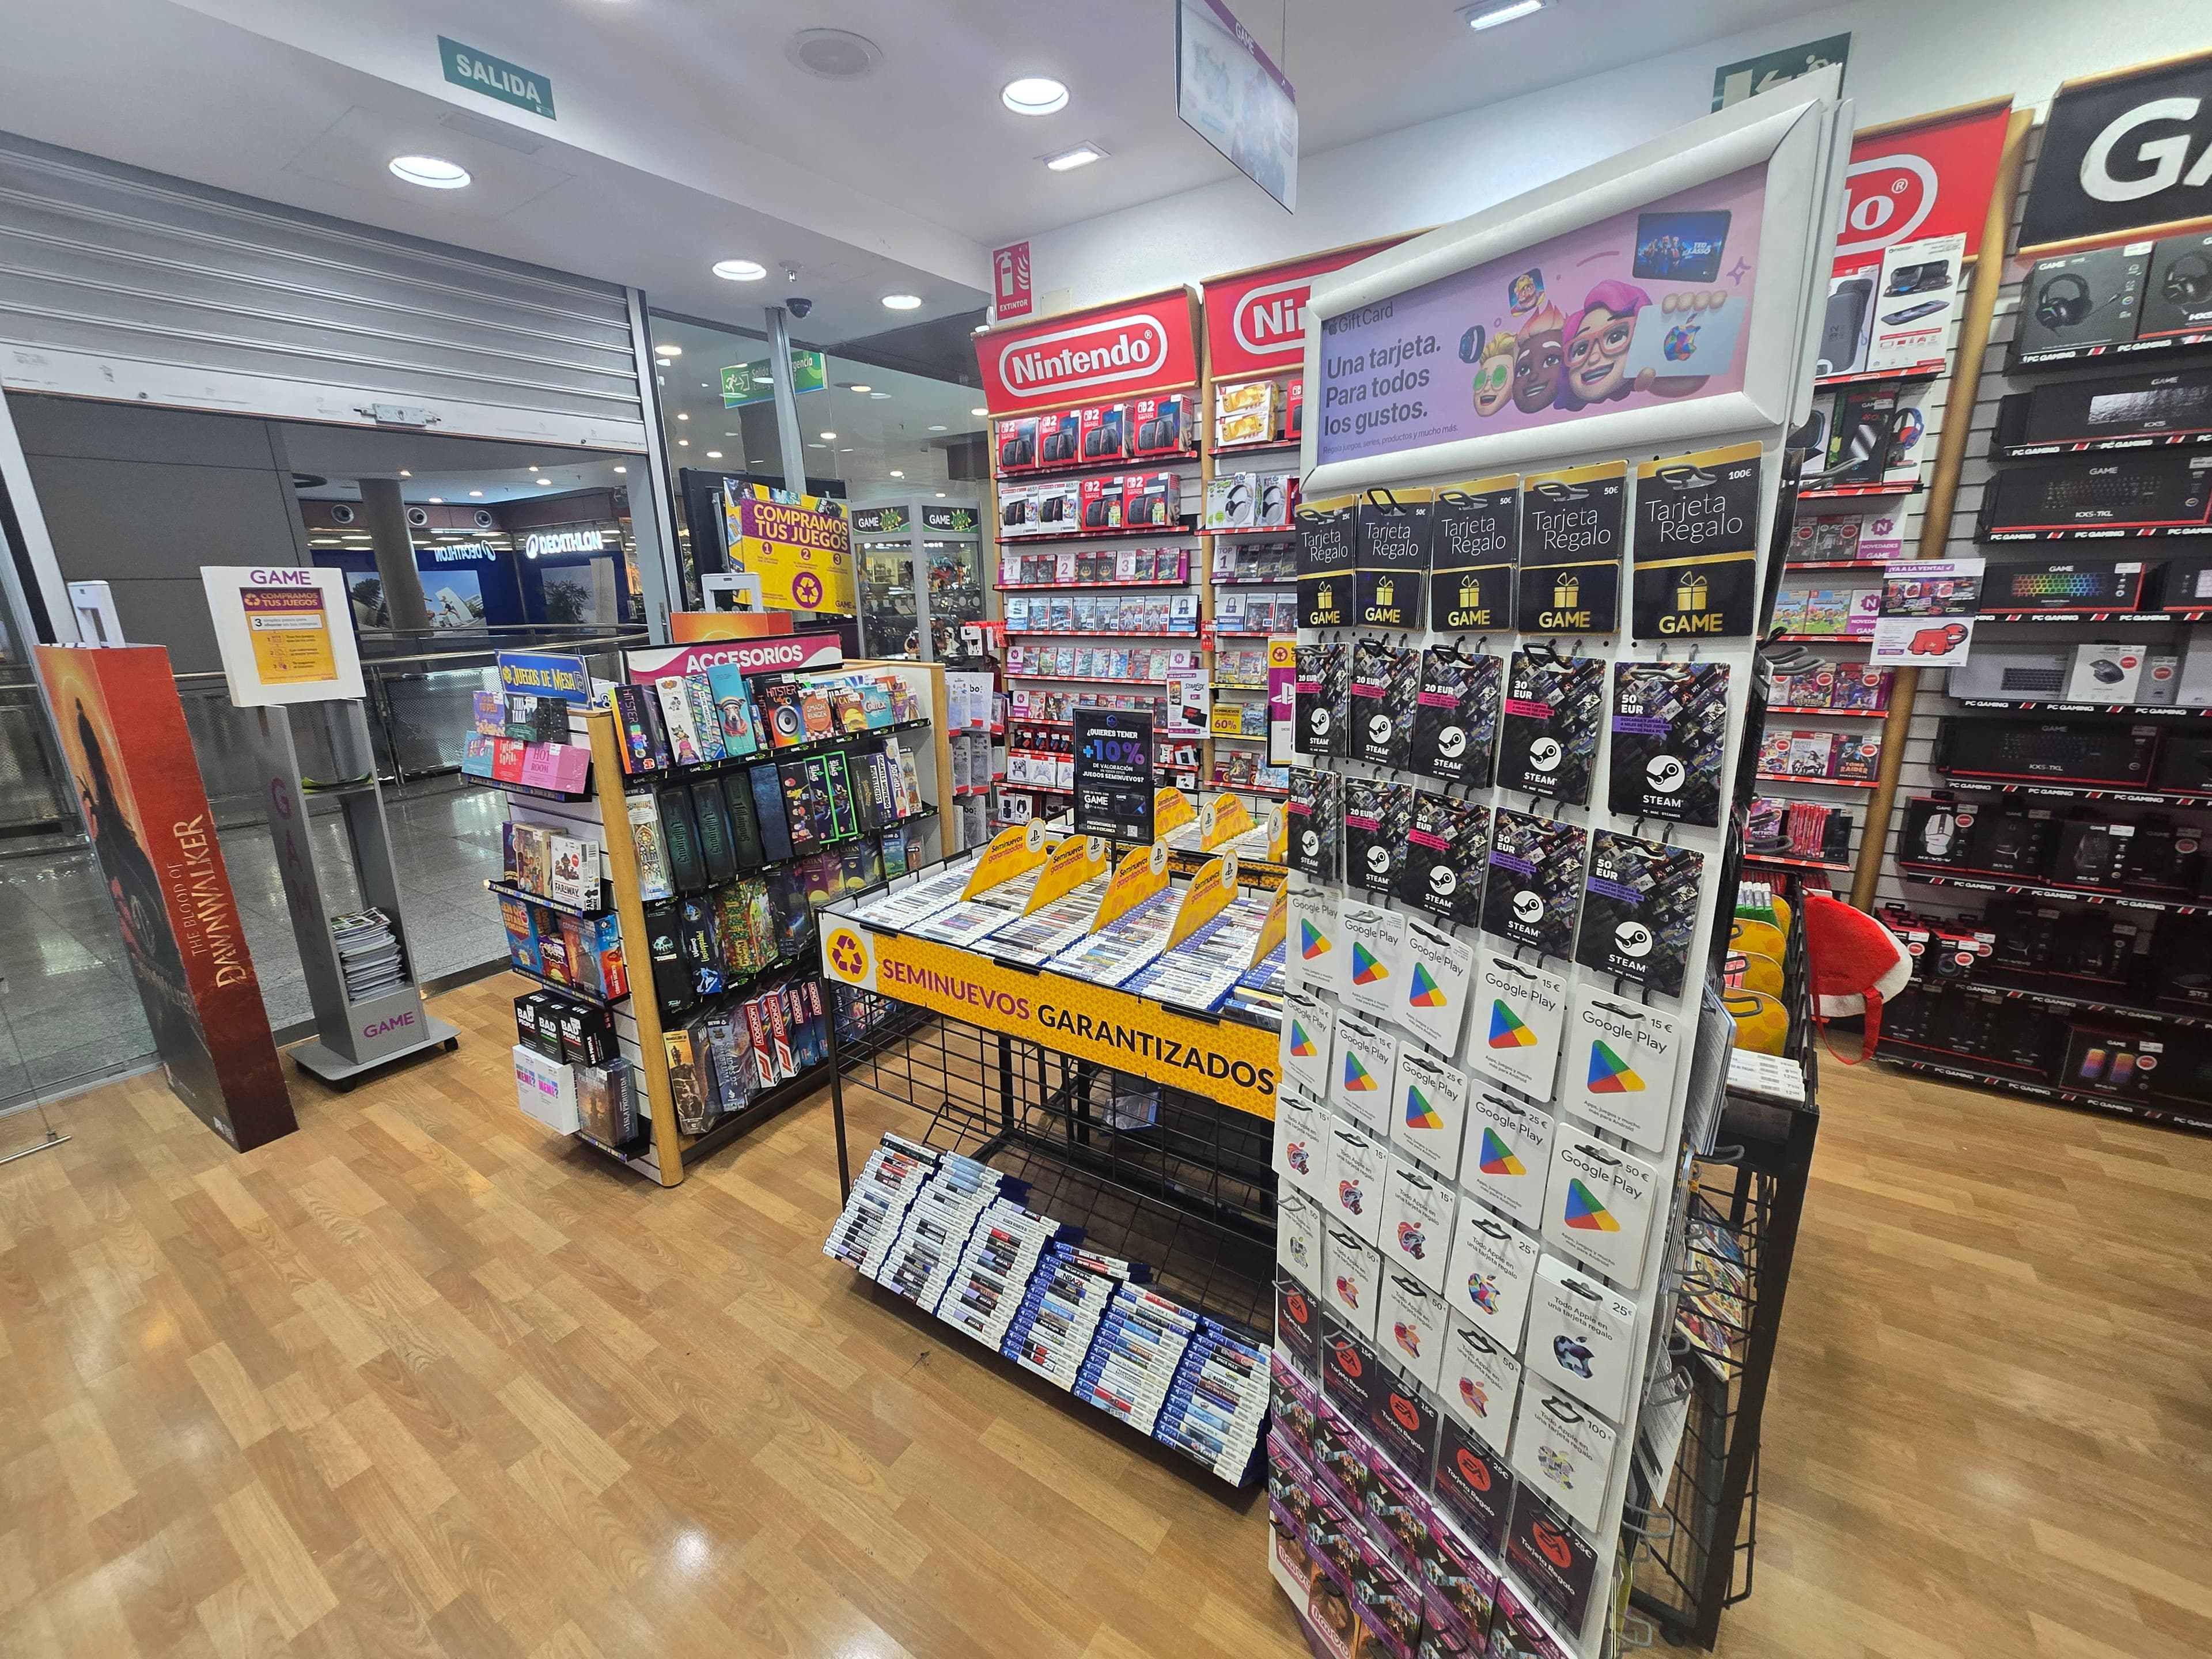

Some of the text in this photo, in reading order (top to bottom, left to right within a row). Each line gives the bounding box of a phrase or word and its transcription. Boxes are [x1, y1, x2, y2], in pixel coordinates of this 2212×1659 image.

[1236, 22, 1254, 55] GAME
[456, 54, 541, 104] SALIDA
[1682, 245, 1711, 256] LASSO
[999, 298, 1028, 312] EXTINTOR
[1339, 301, 1393, 332] Gift Card
[2118, 340, 2172, 352] PC GAMING
[1013, 334, 1151, 384] Nintendo
[1327, 335, 1440, 379] Una tarjeta.
[2026, 351, 2075, 362] PC GAMING
[1326, 368, 1430, 408] Para todos
[1325, 401, 1427, 436] los gustos.
[1363, 438, 1381, 448] series,
[1382, 433, 1411, 445] productos
[1418, 427, 1440, 437] mucho
[1442, 424, 1459, 433] más.
[1728, 468, 1751, 480] 100€
[2089, 467, 2119, 475] GAME
[1604, 486, 1619, 495] 50€
[1500, 496, 1512, 505] 50€
[1645, 493, 1726, 523] Tarjeta
[753, 504, 848, 536] COMPRAMOS
[858, 517, 878, 528] GAME
[929, 514, 950, 525] GAME
[1441, 515, 1495, 539] Tarjeta
[1532, 507, 1598, 532] Tarjeta
[1661, 513, 1743, 543] Regalo
[756, 520, 848, 551] TUS JUEGOS
[1302, 528, 1341, 548] Tarjeta
[1366, 522, 1411, 542] Tarjeta
[1544, 525, 1611, 552] Regalo
[540, 531, 603, 555] DECATHLON
[1452, 534, 1506, 556] Regalo
[764, 543, 840, 564] 1 2 3
[1310, 543, 1348, 563] Regalo
[1061, 563, 1068, 575] 2
[1122, 560, 1129, 572] 3
[1219, 555, 1227, 569] 1
[250, 570, 312, 585] GAME
[255, 619, 262, 627] 3
[1310, 610, 1340, 625] GAME
[1365, 608, 1401, 623] GAME
[1448, 609, 1490, 626] GAME
[1539, 611, 1590, 628] GAME
[1659, 613, 1723, 634] GAME
[686, 645, 804, 674] ACCESORIOS
[511, 664, 577, 691] JUEGOS DE MESA
[1366, 676, 1380, 686] EUR
[1514, 680, 1528, 690] 30
[766, 684, 797, 696] HITSTER
[1425, 684, 1453, 694] 20 EUR
[1513, 689, 1532, 700] EUR
[623, 688, 638, 723] HITSTER
[1622, 694, 1637, 704] 50
[807, 704, 825, 713] SMASH
[1621, 704, 1643, 714] EUR
[1215, 719, 1237, 729] 60%
[1087, 729, 1138, 738] ¿QUIERES TENER
[1083, 739, 1145, 765] +10%
[531, 764, 548, 772] ROOM
[1100, 763, 1133, 771] VALORACIÓN
[1434, 758, 1461, 771] STEAM
[1840, 765, 1869, 774] RAIDER
[1105, 773, 1144, 783] SEMINUEVOS?
[1524, 772, 1555, 786] STEAM
[1084, 795, 1108, 805] GAME
[1643, 795, 1681, 808] STEAM
[670, 819, 689, 863] Villainous
[703, 811, 721, 854] Villainous
[991, 835, 1024, 853] Seminuevos
[988, 842, 1024, 864] garantizados
[1053, 844, 1084, 864] Seminuevos
[1050, 852, 1084, 876] garantizados
[1597, 859, 1612, 869] 50
[173, 814, 247, 988] DAWNWALKER
[173, 883, 197, 928] BLOOD
[187, 930, 208, 957] THE
[1608, 954, 1646, 973] STEAM
[1485, 972, 1556, 1012] Google Play
[1543, 979, 1561, 992] 15 €
[809, 983, 821, 1014] MONOPOLY
[517, 1007, 535, 1022] BAD
[769, 998, 783, 1036] MONOPOLY
[363, 1010, 415, 1040] GAME
[518, 1020, 535, 1029] PEOPLE
[539, 1017, 556, 1032] BAD
[882, 957, 1274, 1093] SEMINUEVOS GARANTIZADOS
[1582, 1010, 1668, 1054] Google Play
[1651, 1018, 1673, 1033] 15 €
[538, 1081, 559, 1099] MEME?
[1613, 1119, 1634, 1131] Android
[1622, 1119, 1641, 1129] mucho
[1561, 1149, 1643, 1200] Google Play
[1626, 1165, 1650, 1182] 50 €
[1548, 1302, 1612, 1340] una tarjeta regalo
[1555, 1297, 1607, 1330] Todo Apple en
[1494, 1463, 1509, 1479] 25€
[1574, 1539, 1593, 1558] 25€
